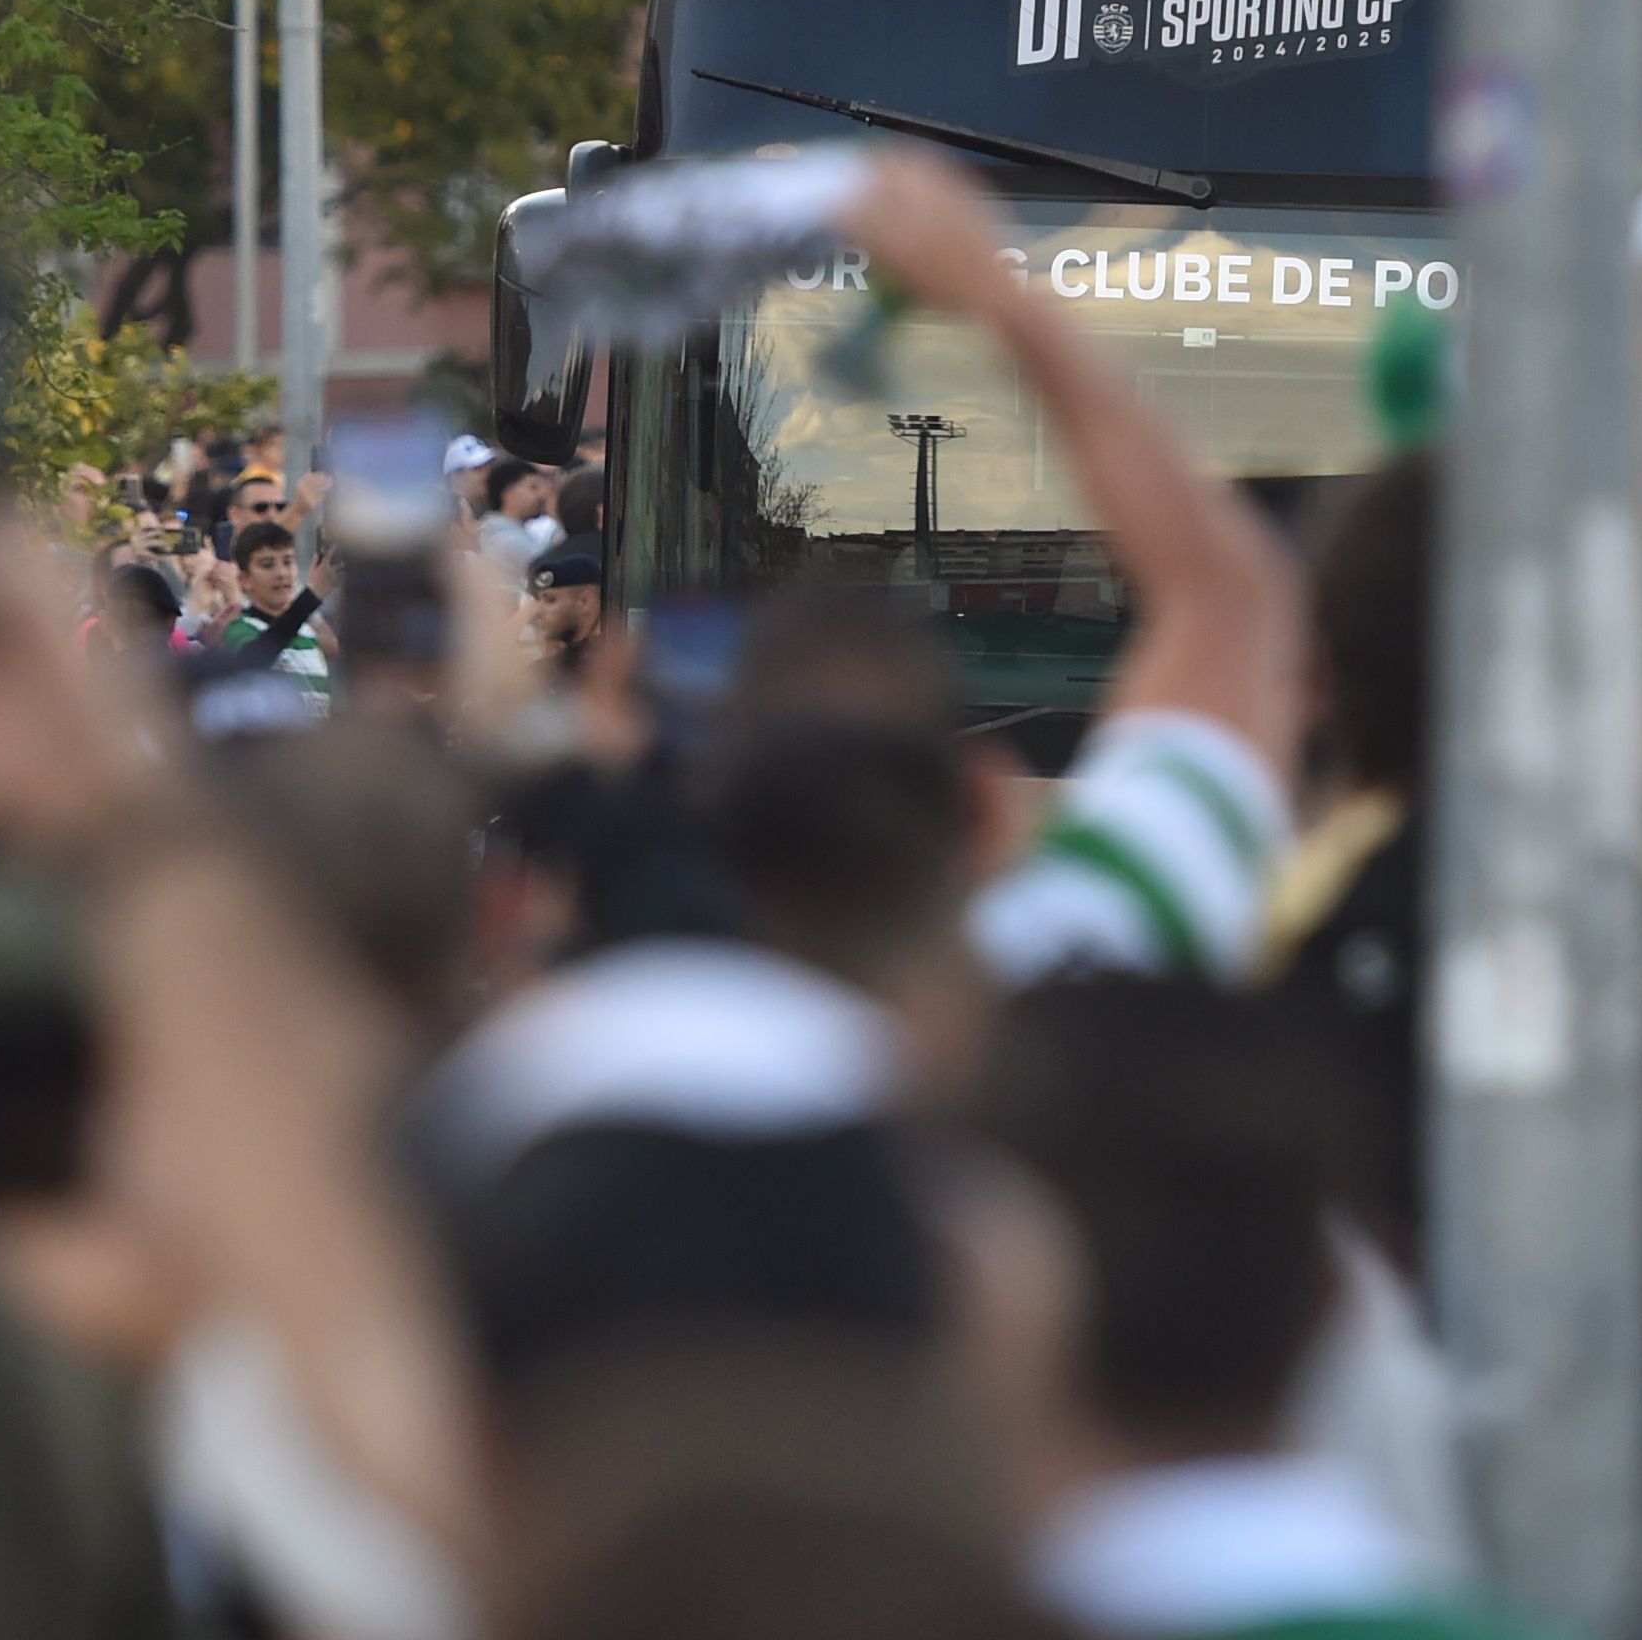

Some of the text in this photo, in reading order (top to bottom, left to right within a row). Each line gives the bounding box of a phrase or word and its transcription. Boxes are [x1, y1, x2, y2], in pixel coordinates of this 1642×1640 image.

[1211, 29, 1391, 64] 2024/2025
[1050, 248, 1253, 304] CLUBE
[1271, 256, 1354, 307] DE
